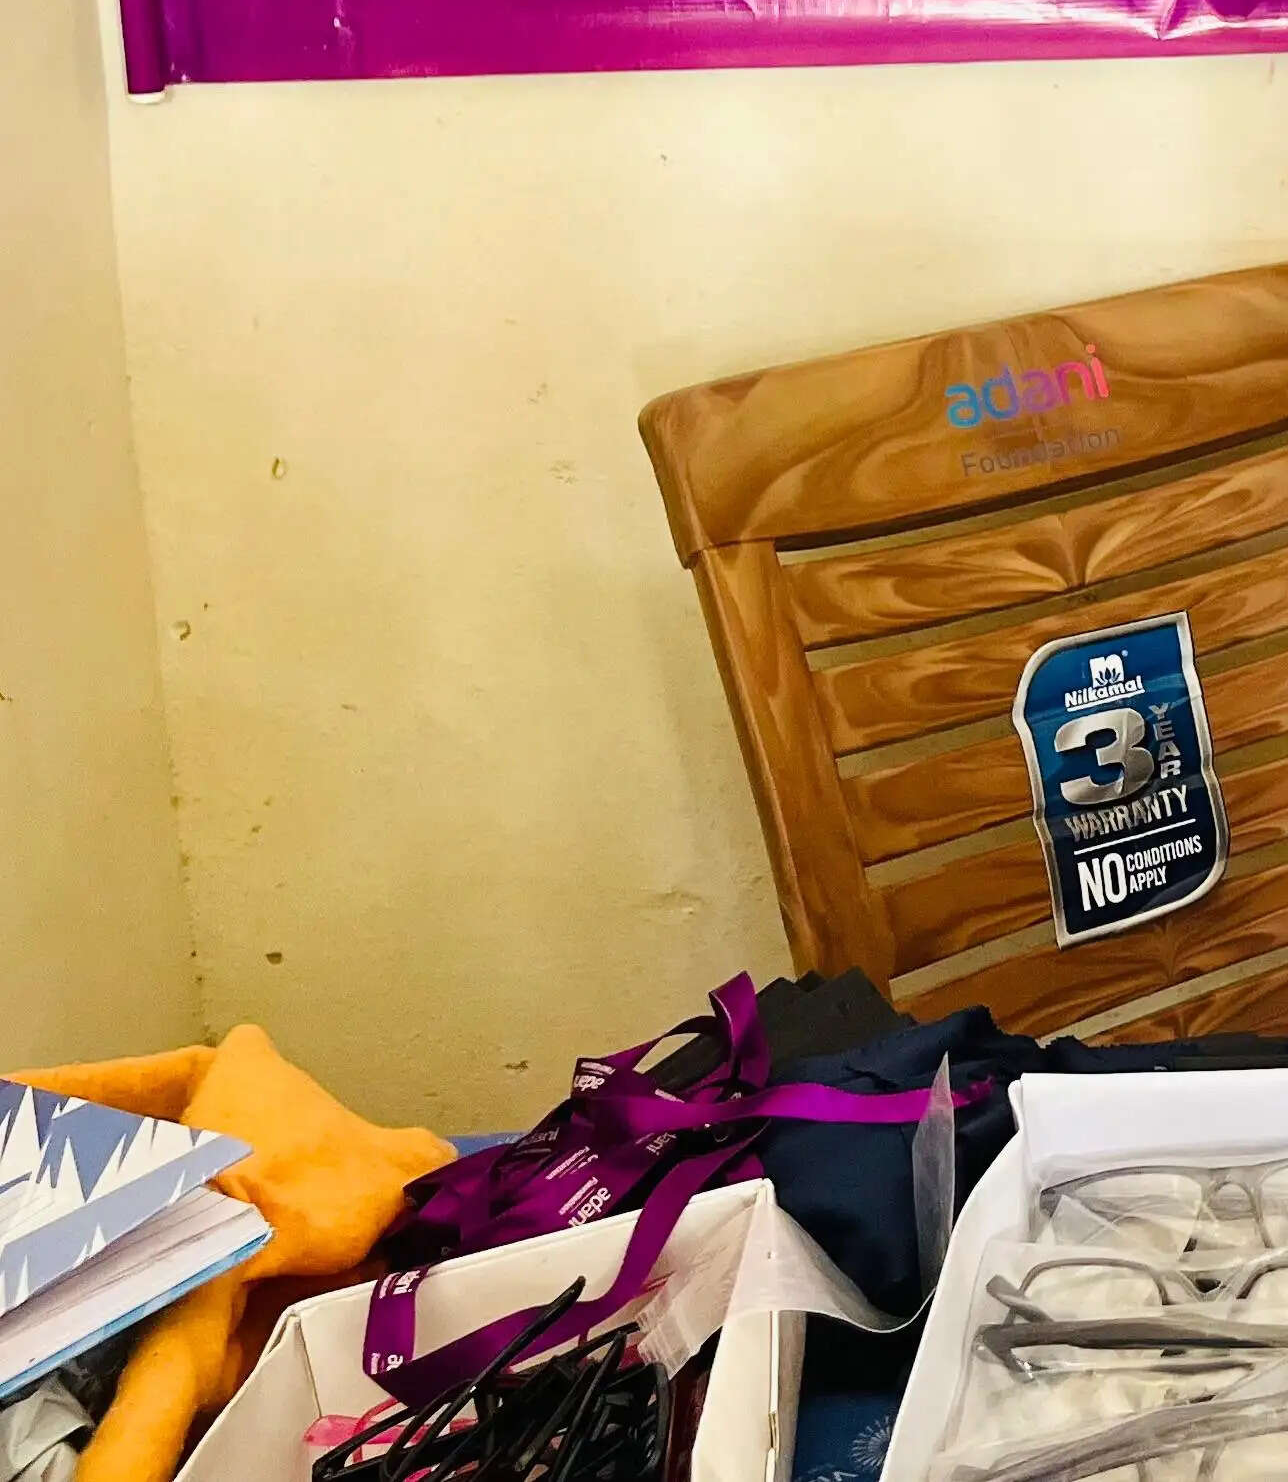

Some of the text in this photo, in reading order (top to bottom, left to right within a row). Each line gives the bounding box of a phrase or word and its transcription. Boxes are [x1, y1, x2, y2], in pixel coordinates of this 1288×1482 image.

[944, 342, 1110, 429] adani
[1065, 676, 1145, 709] Nilkamal
[1054, 701, 1181, 806] 3 YEAR
[1065, 784, 1189, 842] WARRANTY
[1077, 835, 1203, 912] NO CONDITIONS
[1129, 865, 1168, 894] APPLY
